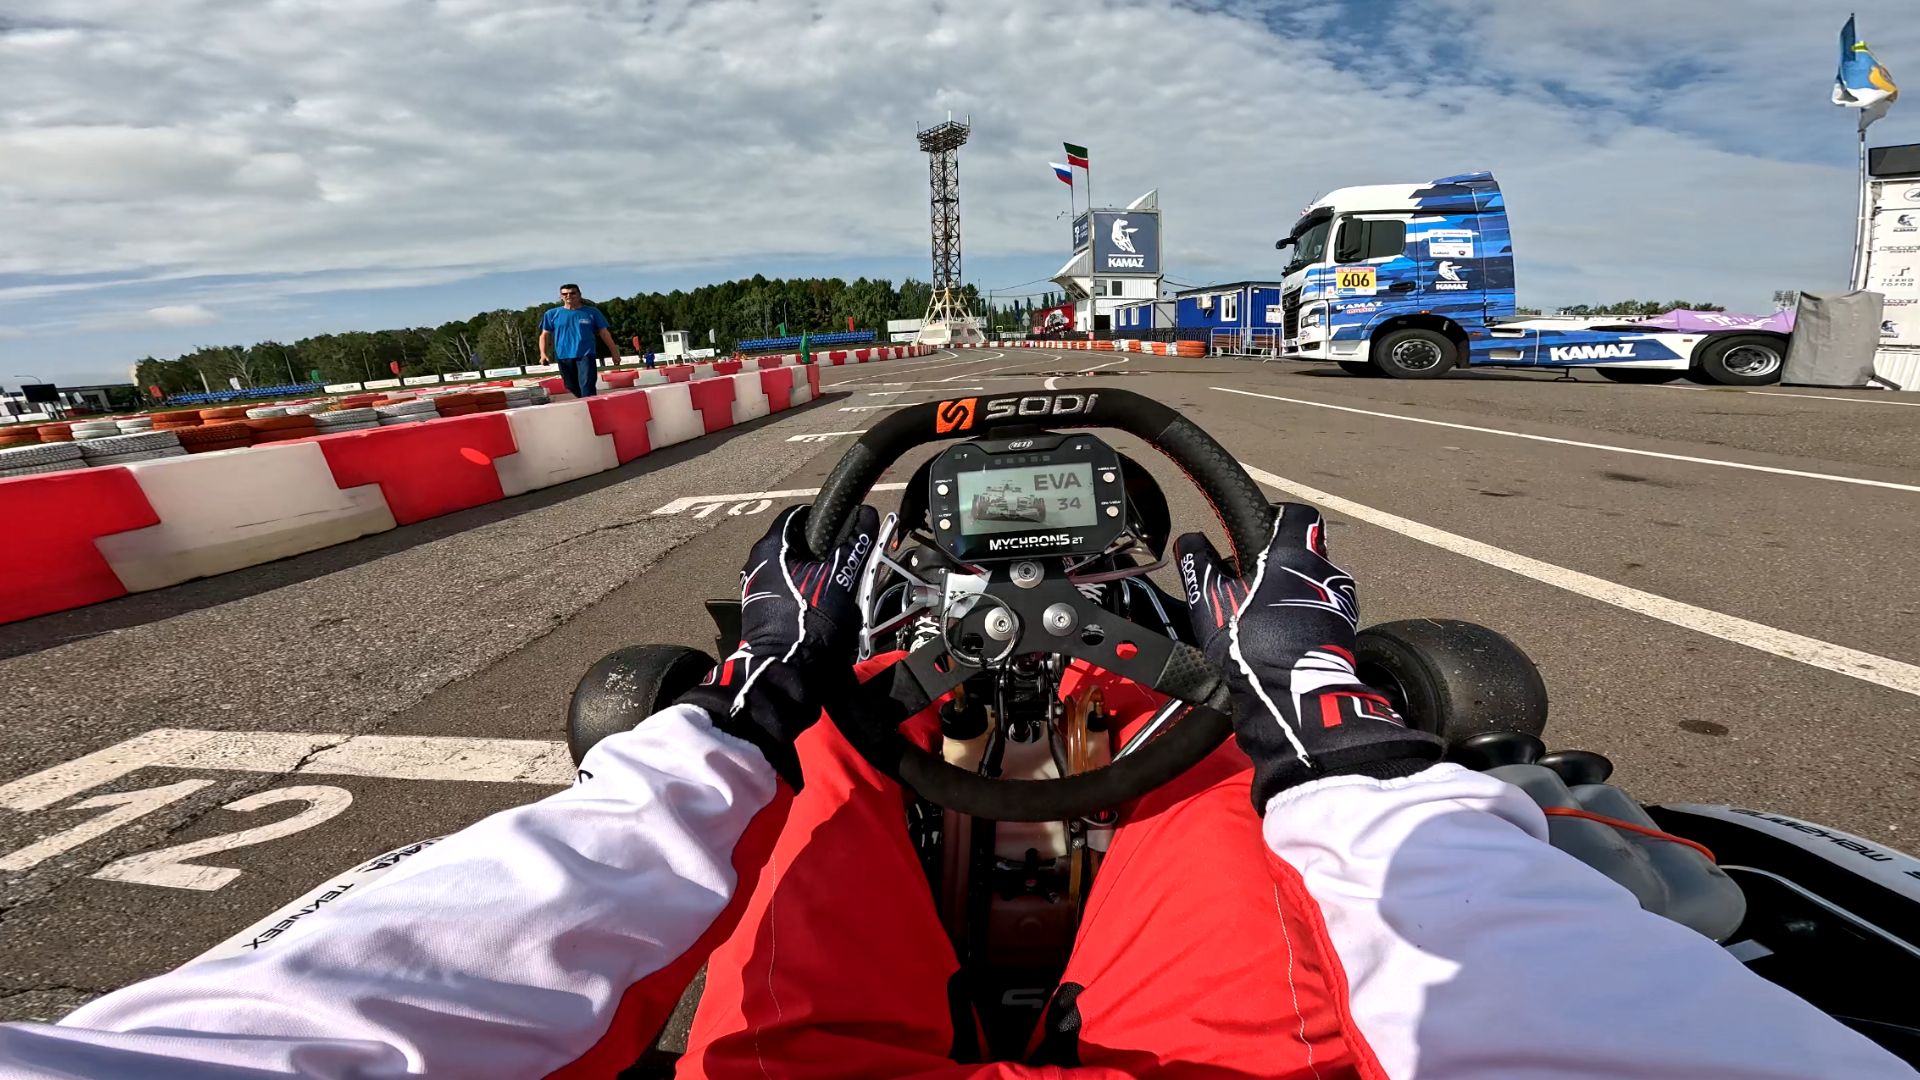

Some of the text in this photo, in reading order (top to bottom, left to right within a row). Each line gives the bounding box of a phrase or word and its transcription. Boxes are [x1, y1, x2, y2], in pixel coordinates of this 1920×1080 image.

[1108, 258, 1144, 267] KAMAZ
[1342, 273, 1369, 287] 606
[1336, 301, 1383, 310] KAMAZ
[1550, 343, 1636, 361] KAMAZ
[985, 393, 1098, 420] SODI
[1033, 472, 1082, 491] EVA
[690, 499, 773, 518] 10
[1057, 497, 1082, 511] 34
[1071, 536, 1084, 545] 2T
[835, 533, 870, 592] sparco
[1179, 552, 1200, 605] sparco
[0, 779, 354, 891] 12
